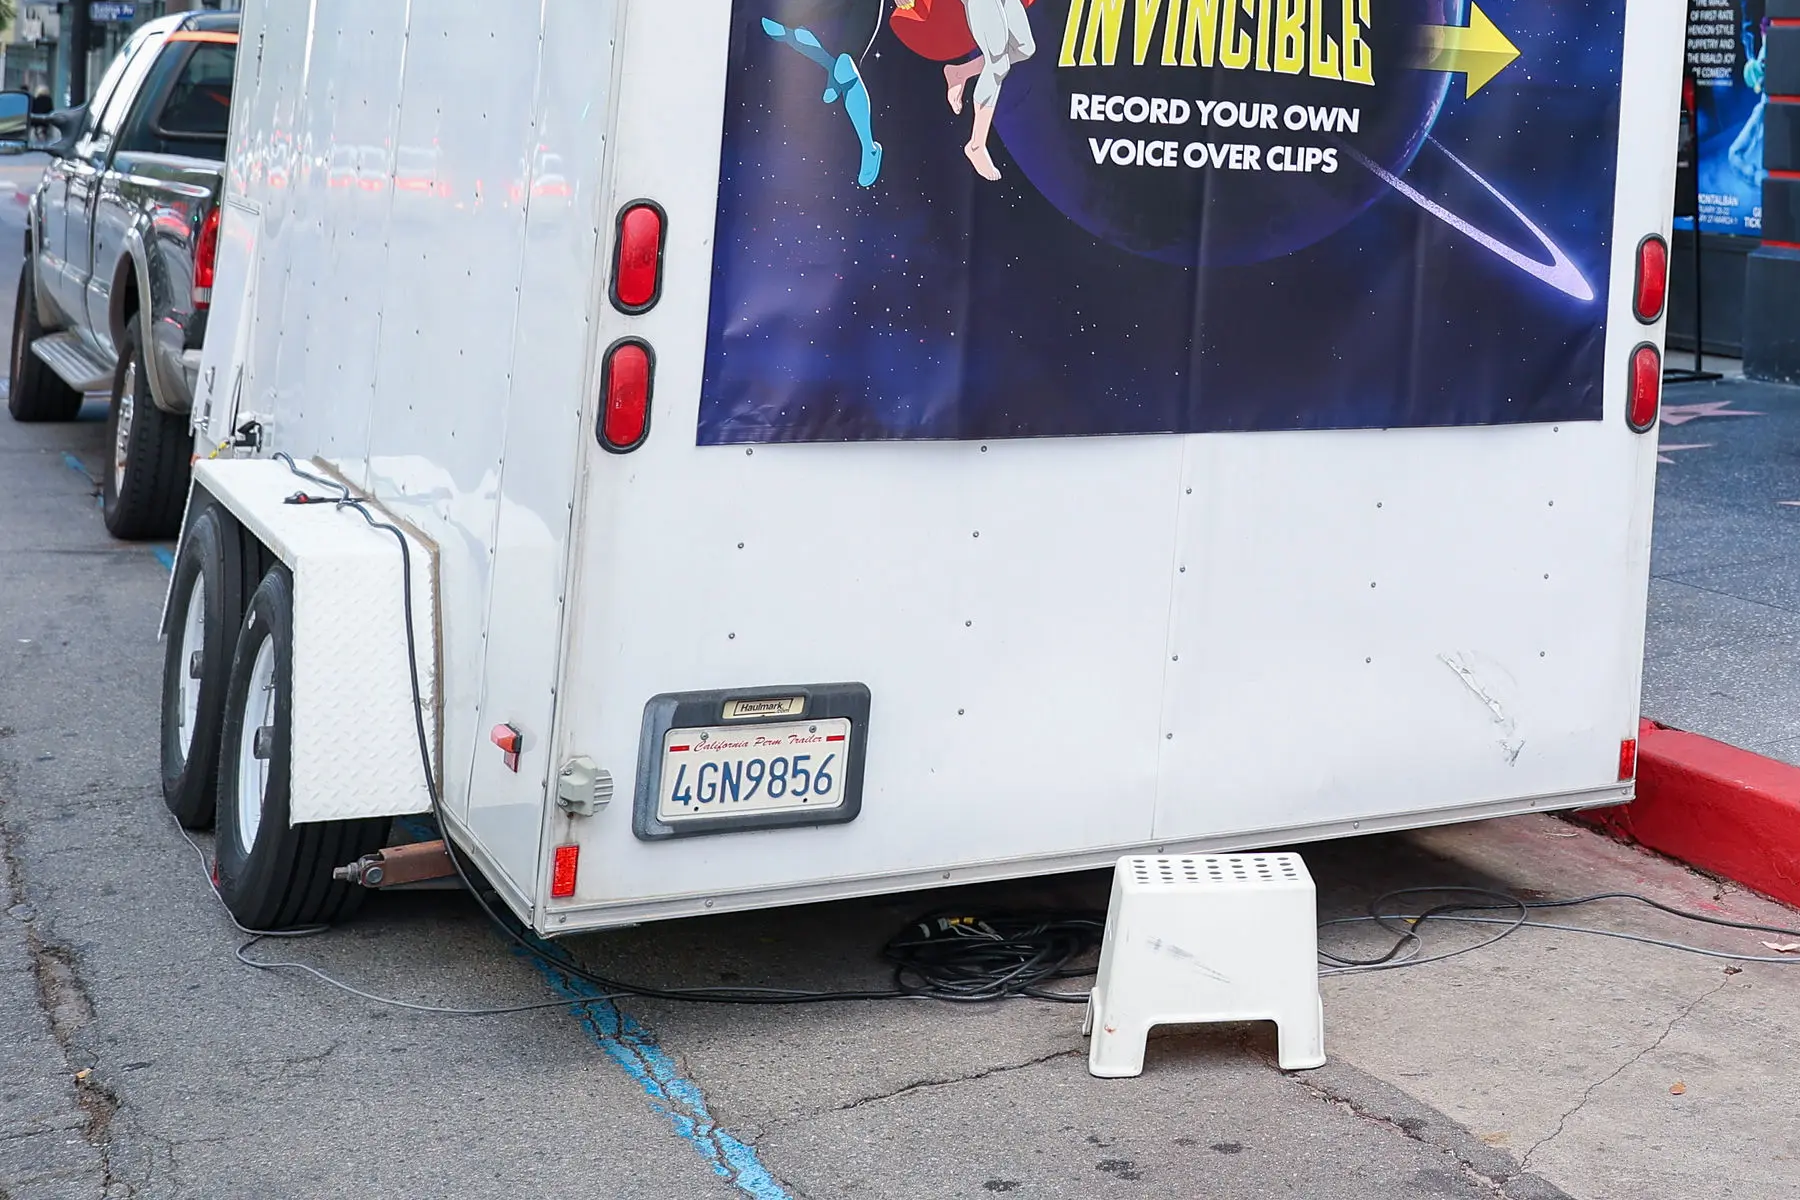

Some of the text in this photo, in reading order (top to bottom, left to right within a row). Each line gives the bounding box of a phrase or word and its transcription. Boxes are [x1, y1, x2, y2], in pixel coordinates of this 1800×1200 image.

[1069, 93, 1361, 134] RECORD YOUR OWN
[1087, 137, 1339, 174] VOICE OVER CLIPS
[740, 700, 784, 714] Haulmark
[693, 733, 823, 753] California Perm Trailer
[671, 752, 837, 807] 4GN9856
